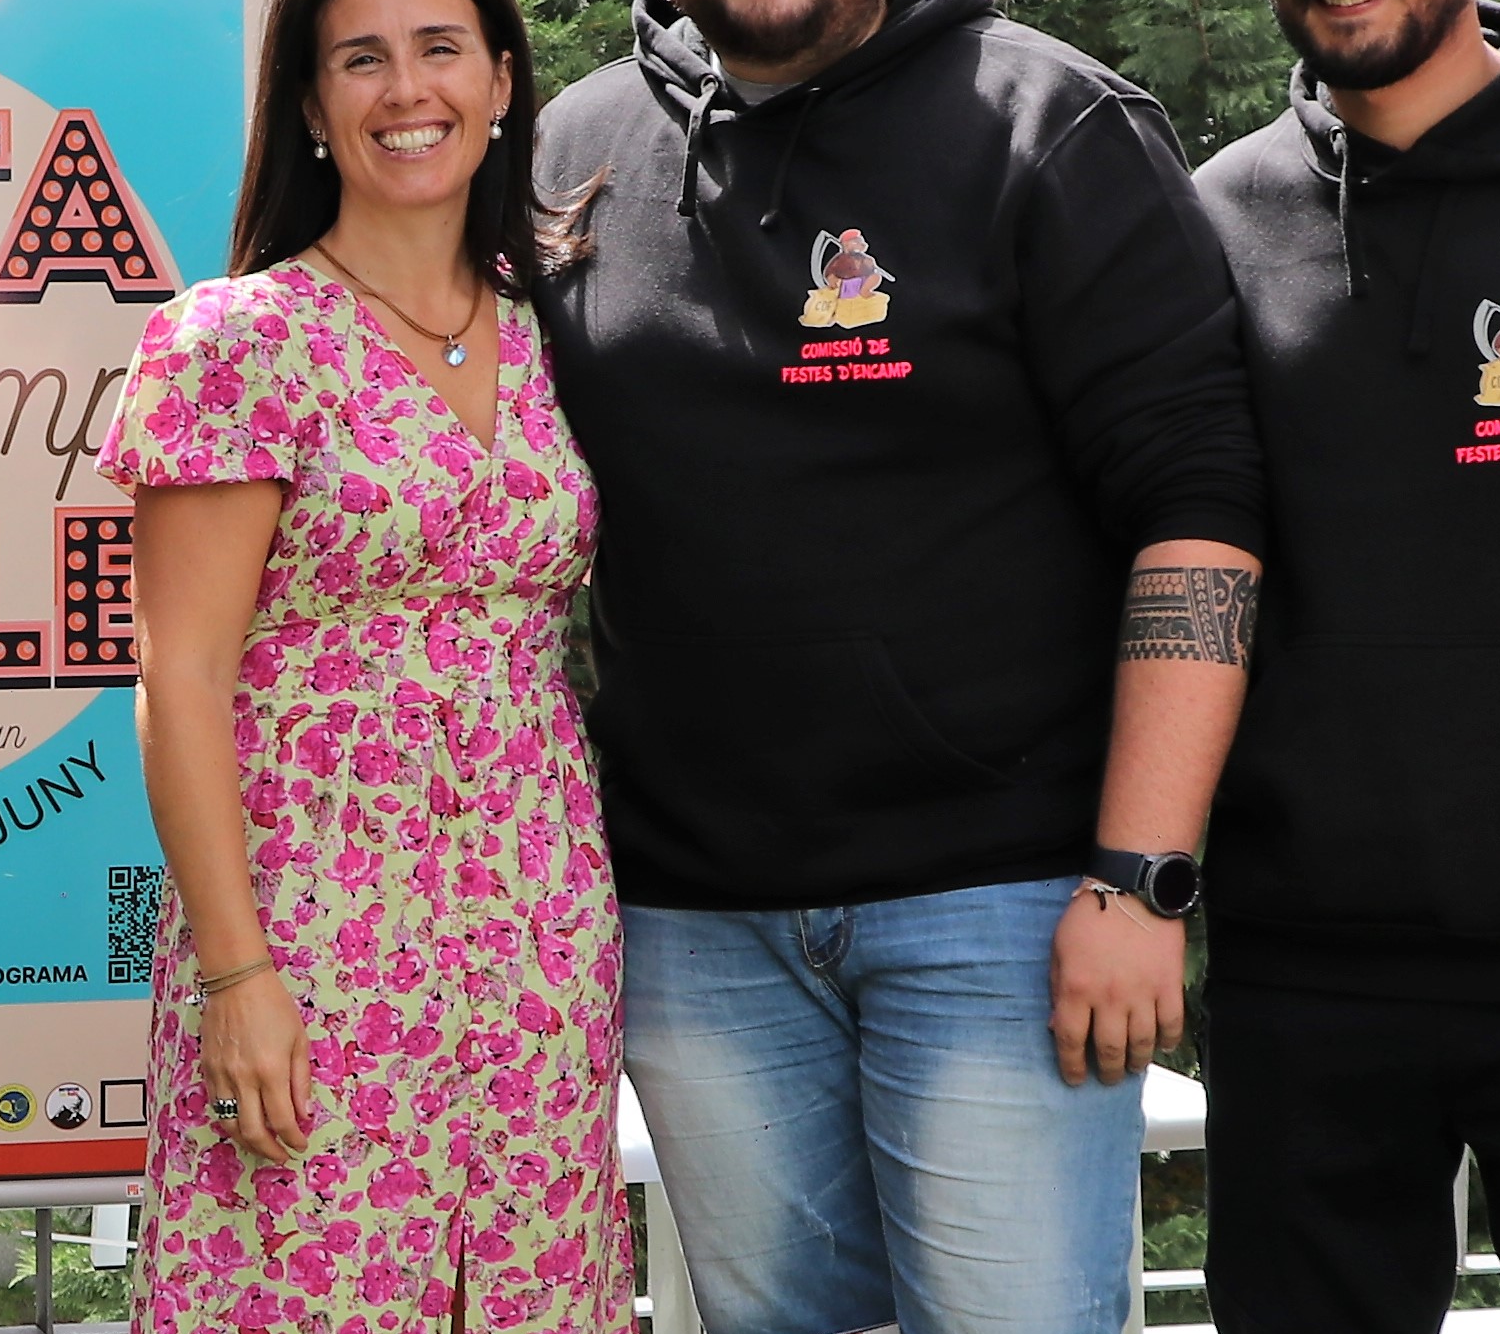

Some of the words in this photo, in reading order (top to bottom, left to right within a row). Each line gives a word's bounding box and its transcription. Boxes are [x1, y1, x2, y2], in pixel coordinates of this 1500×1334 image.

[801, 337, 863, 360] COMISSIÓ
[867, 338, 890, 355] DE
[782, 365, 832, 383] FESTES
[837, 362, 912, 381] D'ENCAMP
